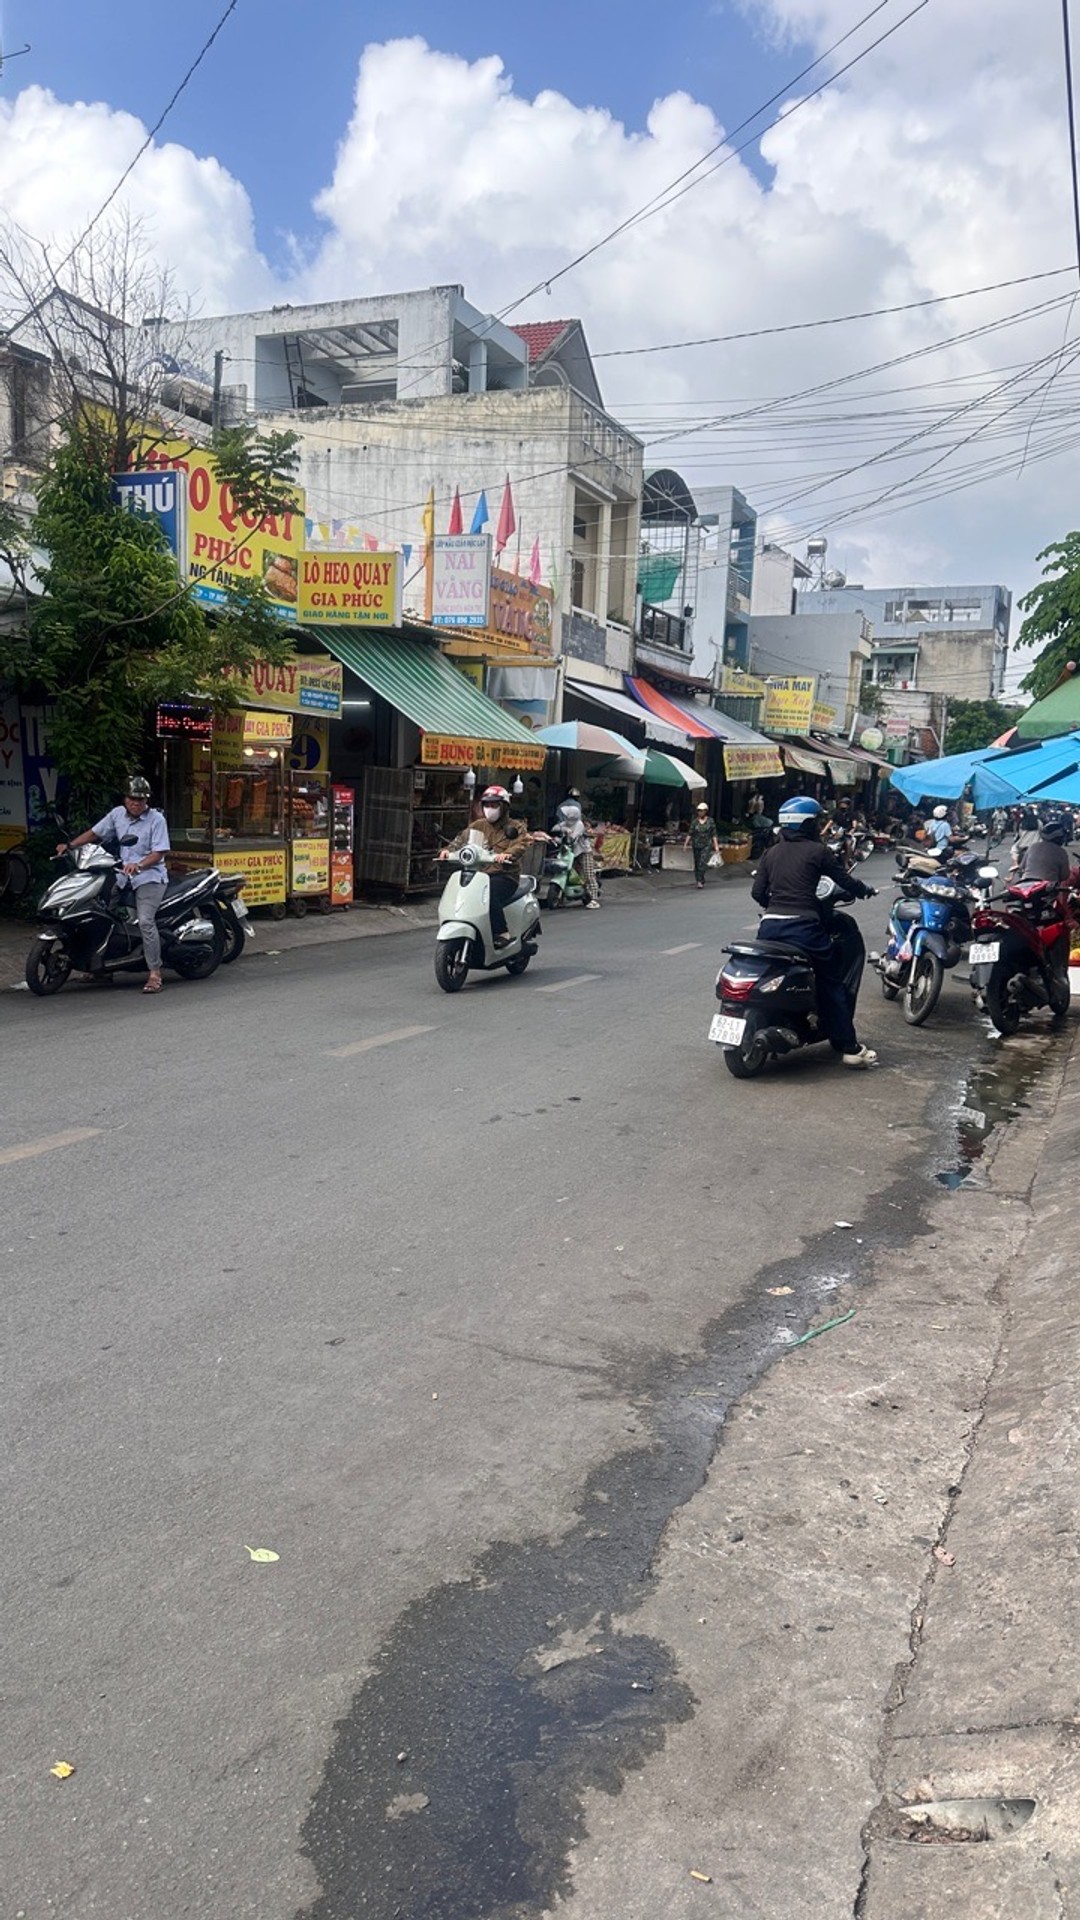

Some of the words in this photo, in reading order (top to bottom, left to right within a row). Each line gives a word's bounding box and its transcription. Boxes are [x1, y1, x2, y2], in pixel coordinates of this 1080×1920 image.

[117, 477, 175, 513] THÚ
[193, 532, 252, 570] PHÚC
[445, 553, 476, 570] NAI
[303, 555, 320, 585] LÒ
[323, 561, 349, 585] HEO
[353, 562, 391, 590] QUAY
[310, 592, 337, 606] GIA
[342, 590, 383, 608] PHÚC
[303, 610, 323, 618] GIAO
[253, 659, 297, 696] QUAY
[792, 681, 813, 692] MAY
[289, 733, 321, 771] 9
[440, 740, 475, 760] HÙNG
[247, 856, 262, 867] GIA
[263, 852, 284, 866] PHÚC
